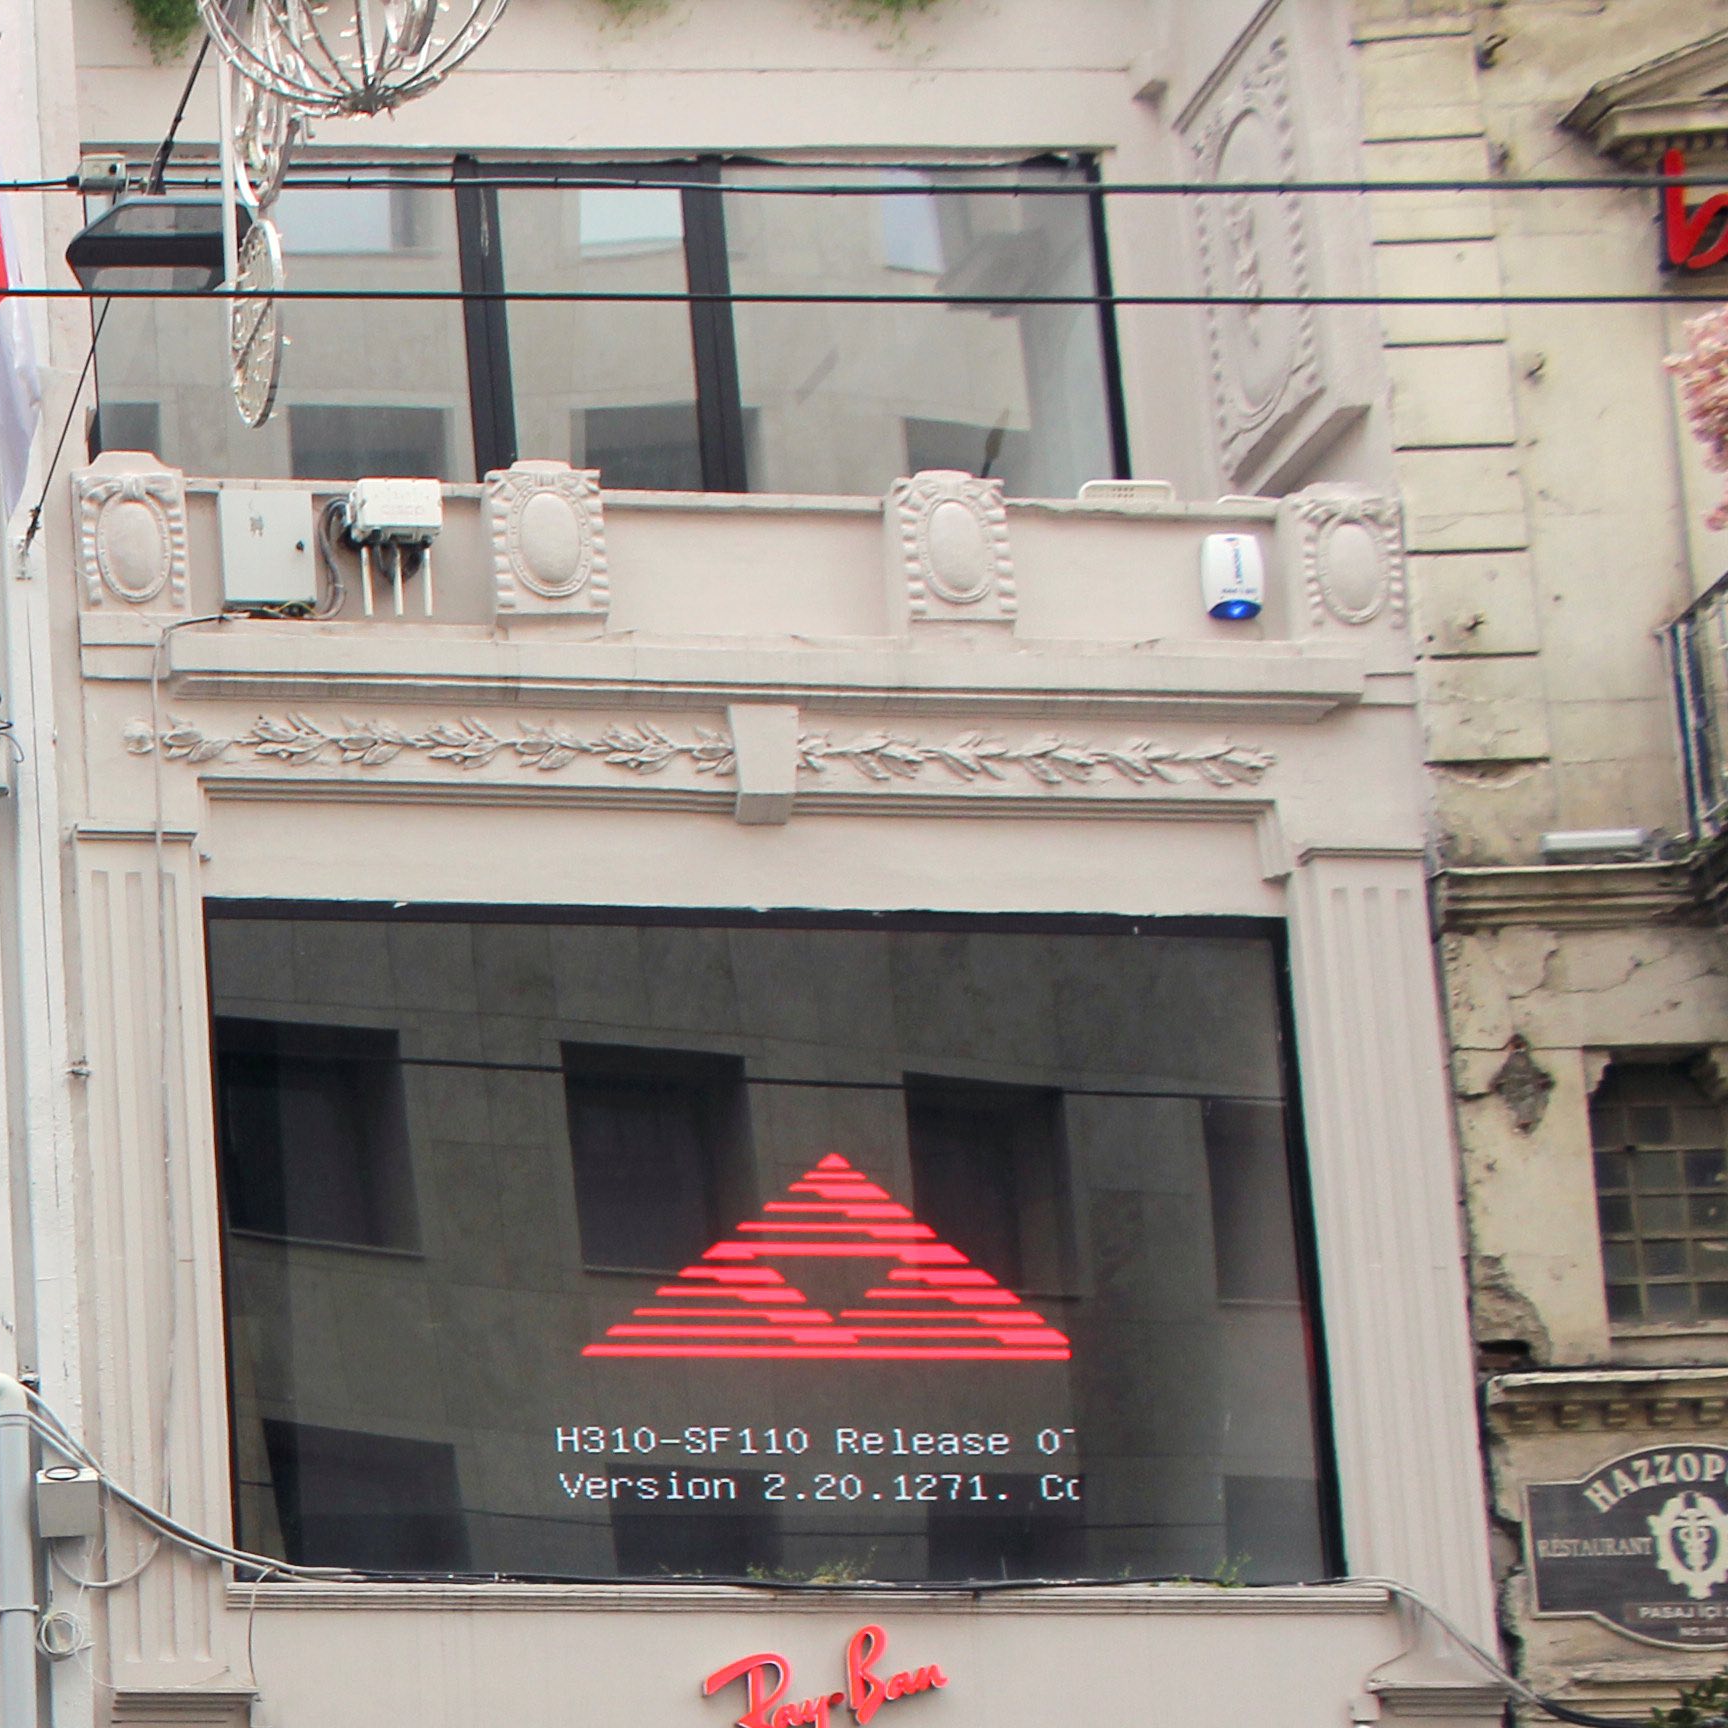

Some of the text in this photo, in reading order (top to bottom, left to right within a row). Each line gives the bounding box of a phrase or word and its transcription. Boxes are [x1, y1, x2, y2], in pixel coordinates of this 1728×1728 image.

[555, 1426, 809, 1455] H310-SF110
[836, 1426, 1010, 1455] Release
[559, 1473, 736, 1501] Version
[763, 1473, 1008, 1501] 2.20.1271.
[1582, 1452, 1728, 1514] HAZZOP
